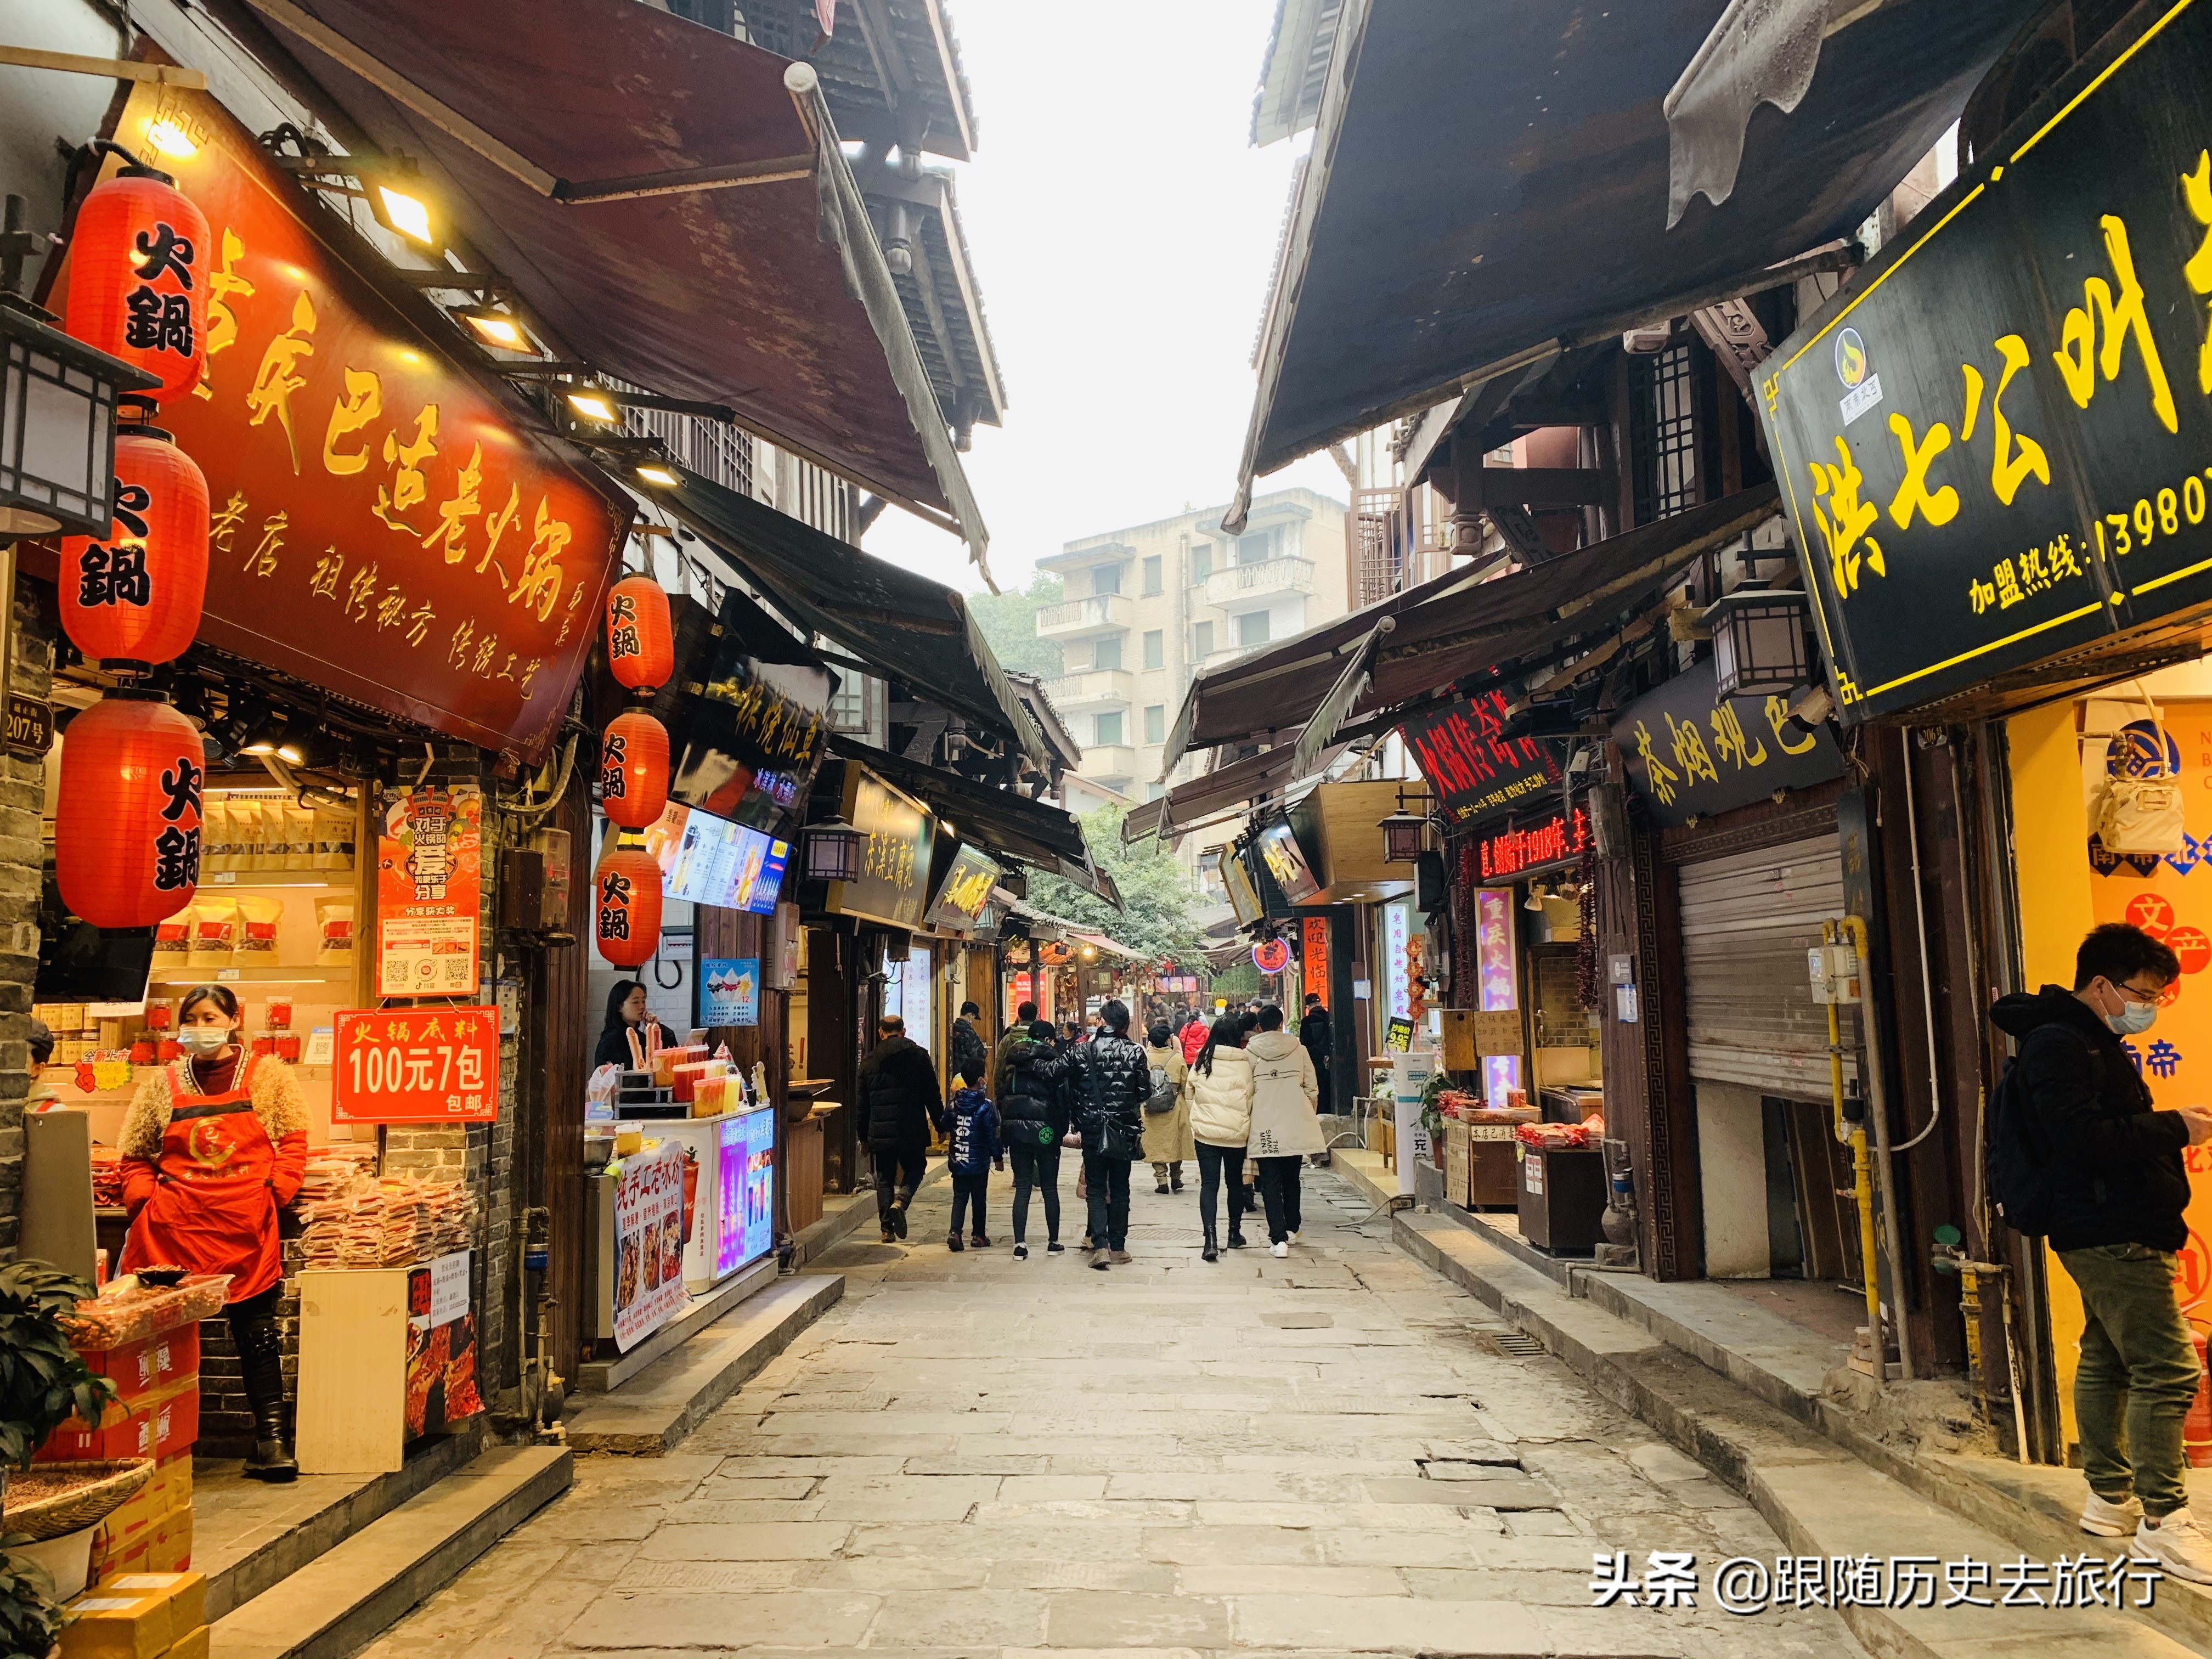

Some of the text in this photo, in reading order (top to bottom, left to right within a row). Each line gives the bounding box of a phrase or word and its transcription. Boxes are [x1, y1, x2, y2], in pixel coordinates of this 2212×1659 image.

[609, 594, 641, 661] 火鍋
[7, 714, 43, 744] 207号
[414, 833, 447, 845] 火锅的
[414, 845, 446, 875] 爱
[415, 884, 447, 900] 分享
[351, 1017, 479, 1045] 火锅底料
[83, 1048, 132, 1063] 全新上市
[349, 1043, 484, 1093] 100元7包
[445, 1094, 482, 1113] 包邮
